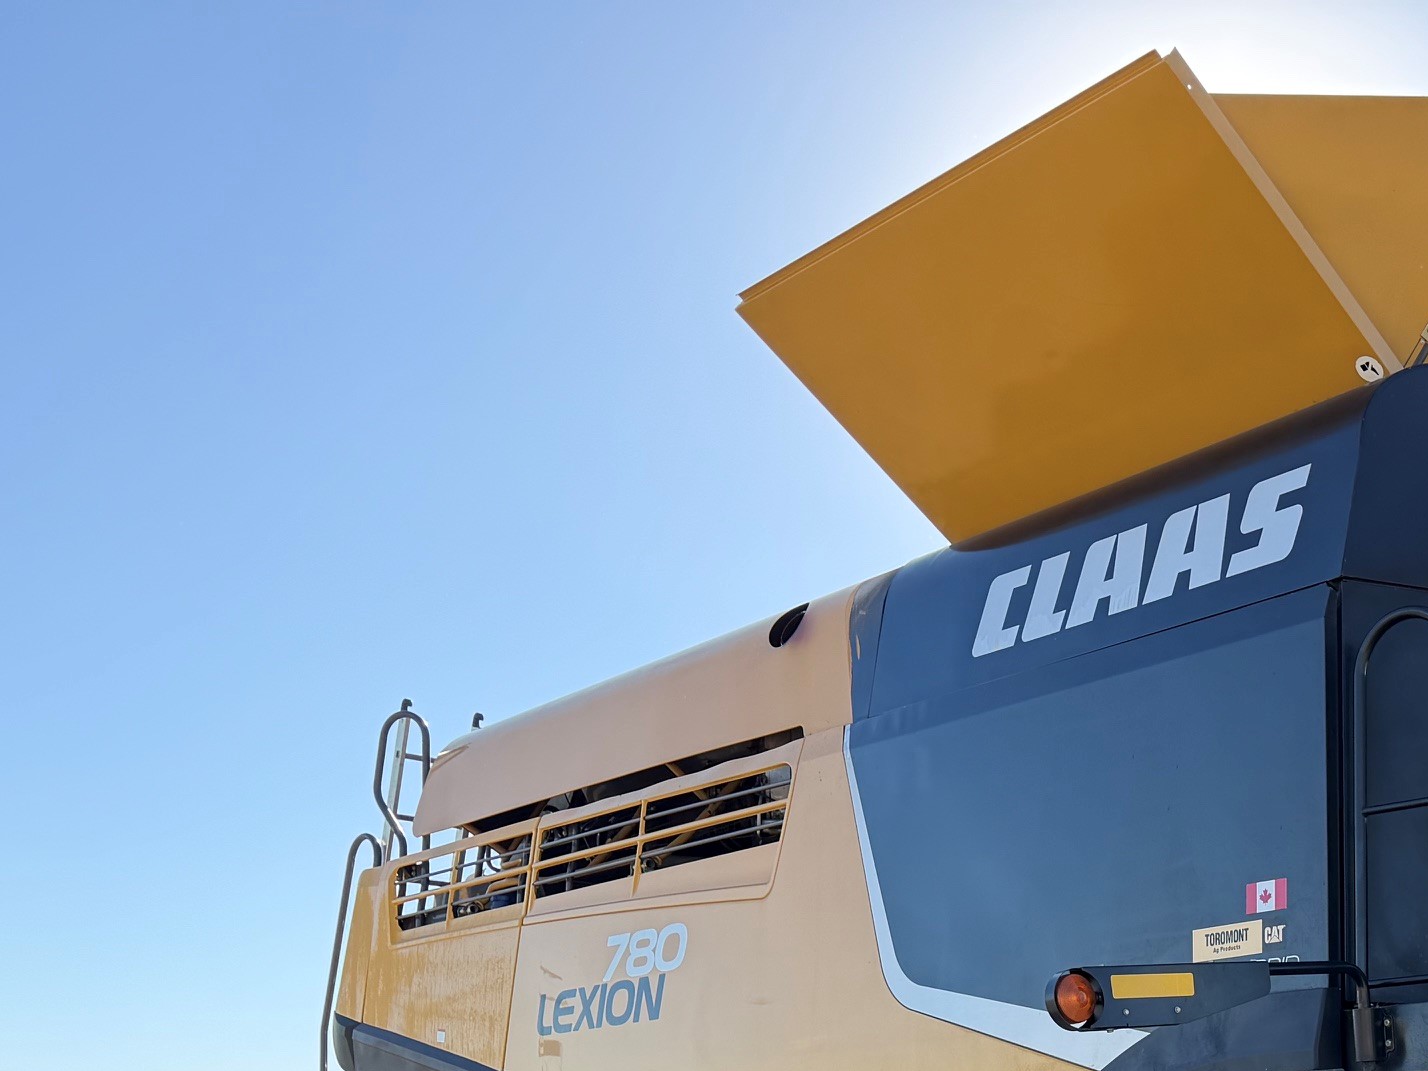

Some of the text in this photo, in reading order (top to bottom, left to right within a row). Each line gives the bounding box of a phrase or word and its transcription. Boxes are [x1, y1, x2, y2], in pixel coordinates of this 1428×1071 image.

[971, 462, 1312, 658] CLAAS
[603, 922, 688, 982] 780
[1204, 927, 1250, 947] TOROMONT
[1212, 944, 1241, 954] Ag Products
[1264, 924, 1287, 944] CAT
[536, 973, 666, 1037] LEXION
